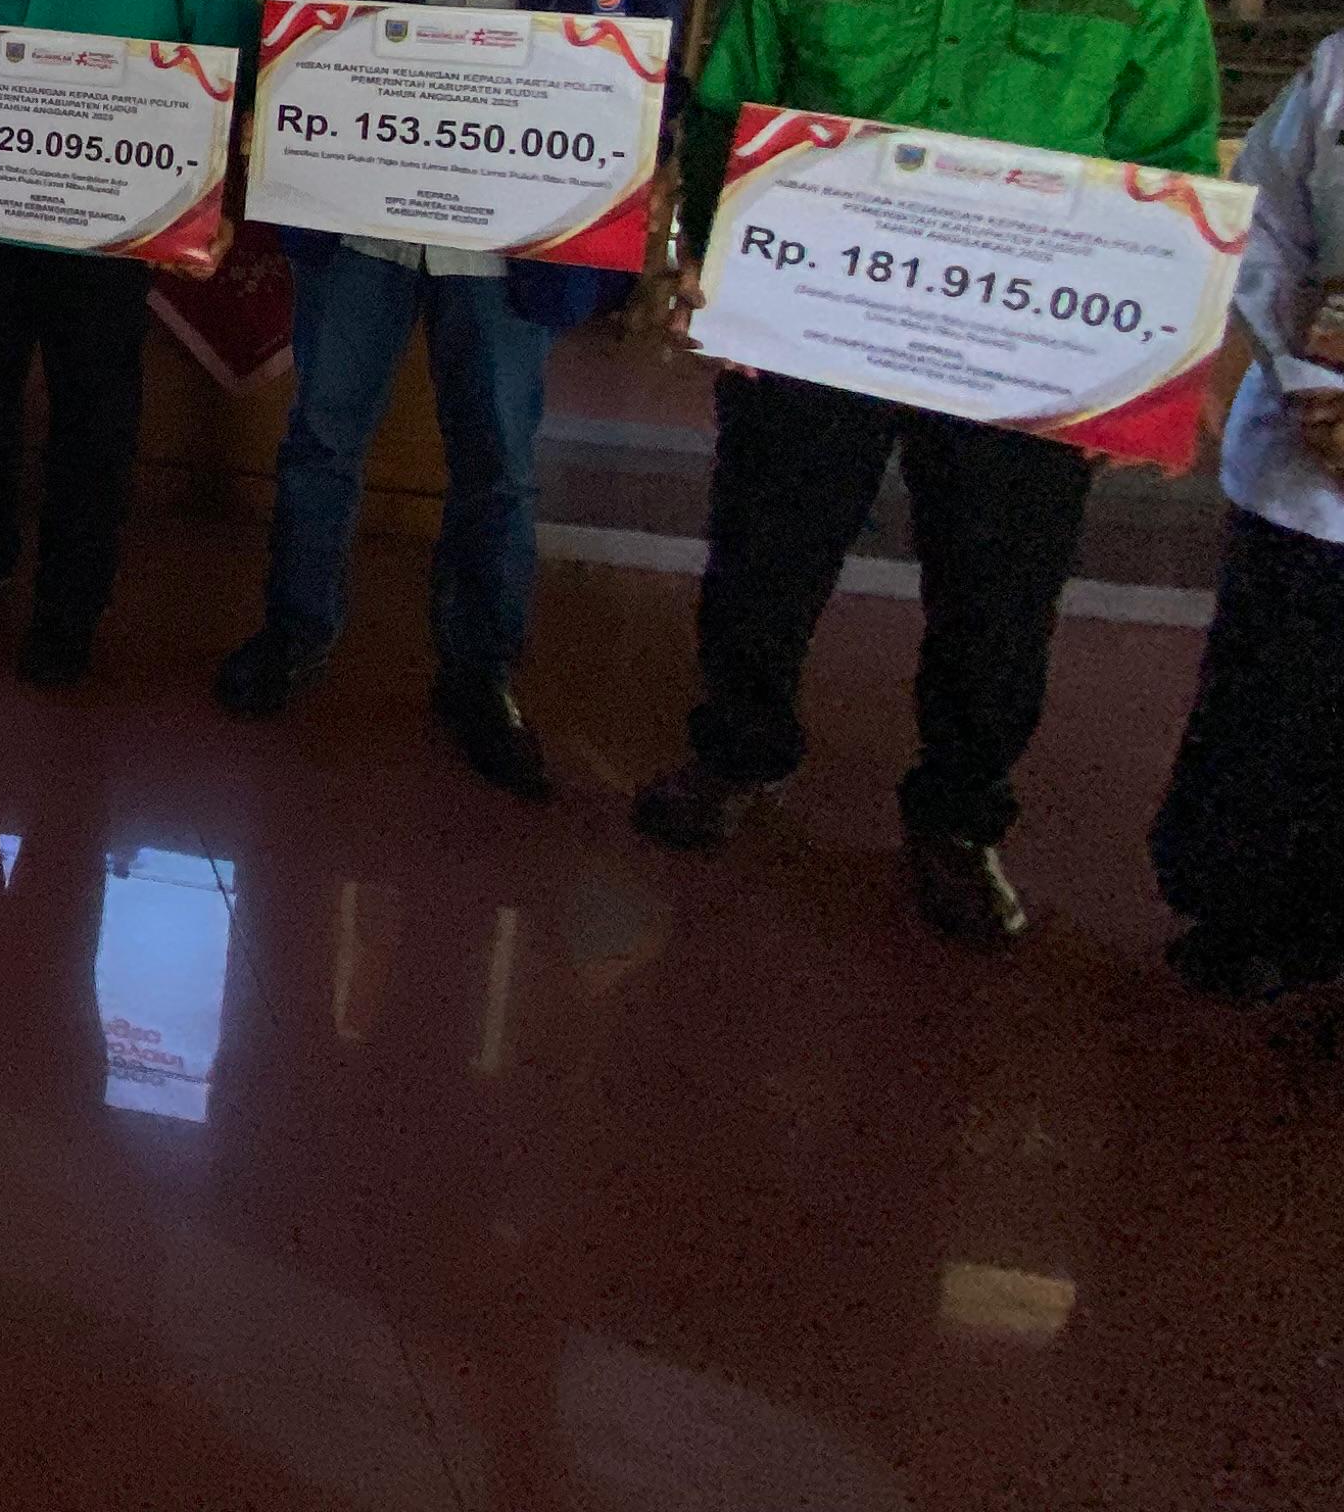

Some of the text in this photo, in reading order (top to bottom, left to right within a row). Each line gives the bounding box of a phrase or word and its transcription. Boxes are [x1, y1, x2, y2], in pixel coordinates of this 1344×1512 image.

[277, 104, 625, 169] Rp. 153.550.000,-
[740, 223, 816, 271] Rp.
[840, 245, 1178, 344] 181.915.000,-
